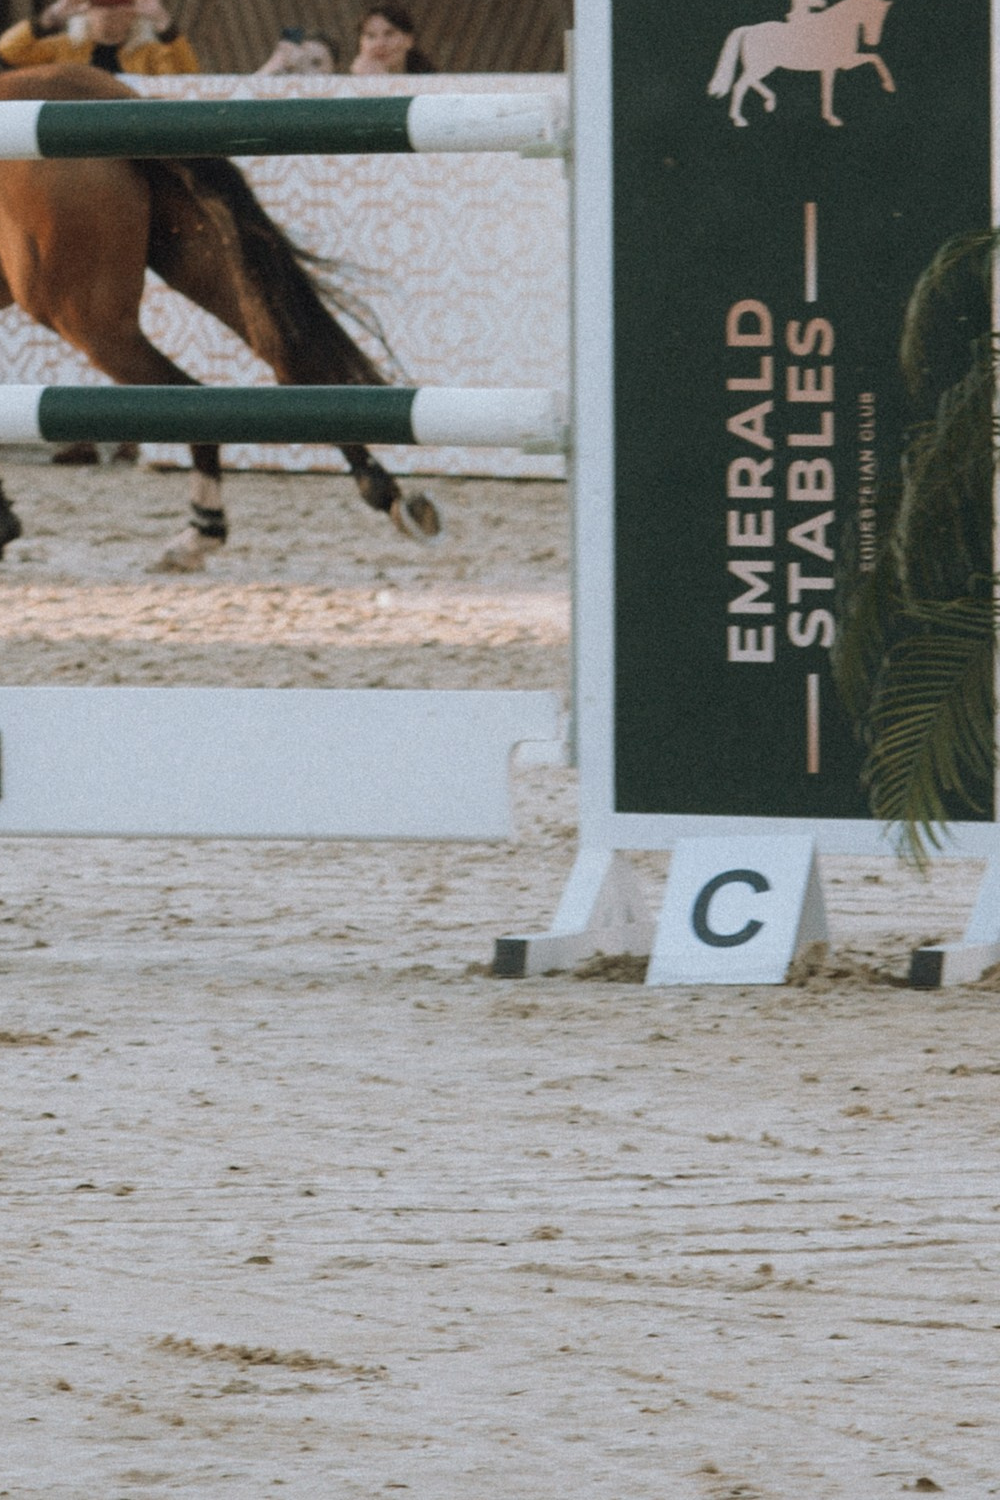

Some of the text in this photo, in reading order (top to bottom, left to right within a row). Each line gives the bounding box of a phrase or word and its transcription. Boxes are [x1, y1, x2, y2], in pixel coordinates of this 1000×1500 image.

[726, 297, 775, 664] EMERALD
[786, 316, 835, 649] STABLES
[857, 391, 876, 442] CLUB
[692, 868, 770, 947] C
